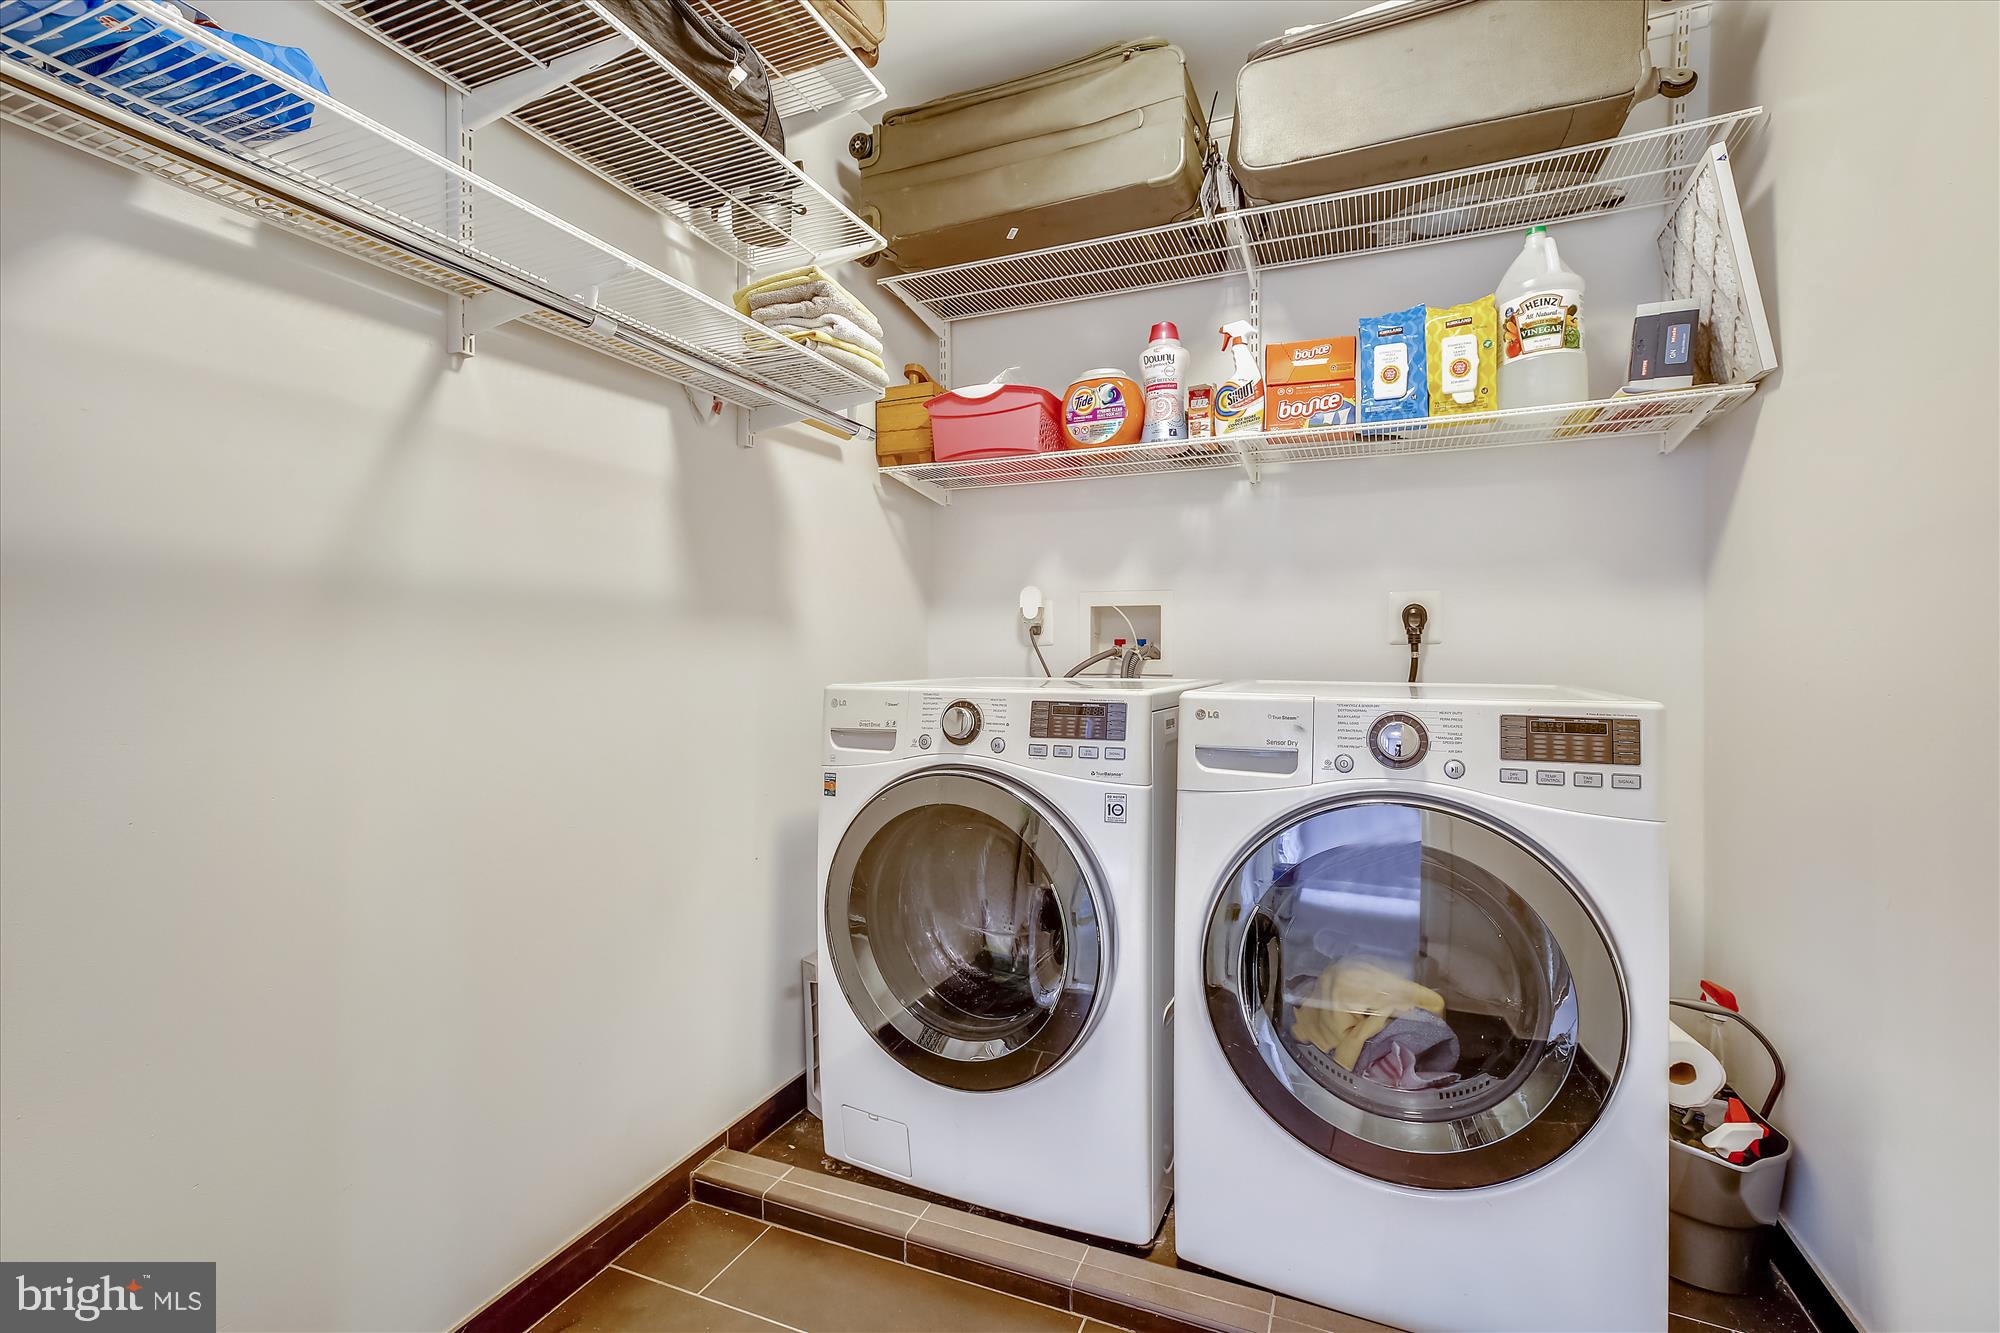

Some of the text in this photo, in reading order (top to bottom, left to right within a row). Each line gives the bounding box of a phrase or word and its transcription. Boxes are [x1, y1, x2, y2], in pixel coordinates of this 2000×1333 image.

[1525, 297, 1558, 311] HEINZ
[1536, 310, 1558, 318] Natural
[1446, 318, 1472, 327] KIRKLAND
[1379, 327, 1403, 336] KIRKLAND
[1520, 325, 1562, 338] VINEGAR
[1294, 344, 1331, 361] bounce
[1144, 354, 1175, 365] Downy
[1074, 395, 1093, 410] Tide
[1278, 393, 1342, 419] bounce
[1108, 804, 1124, 816] 10
